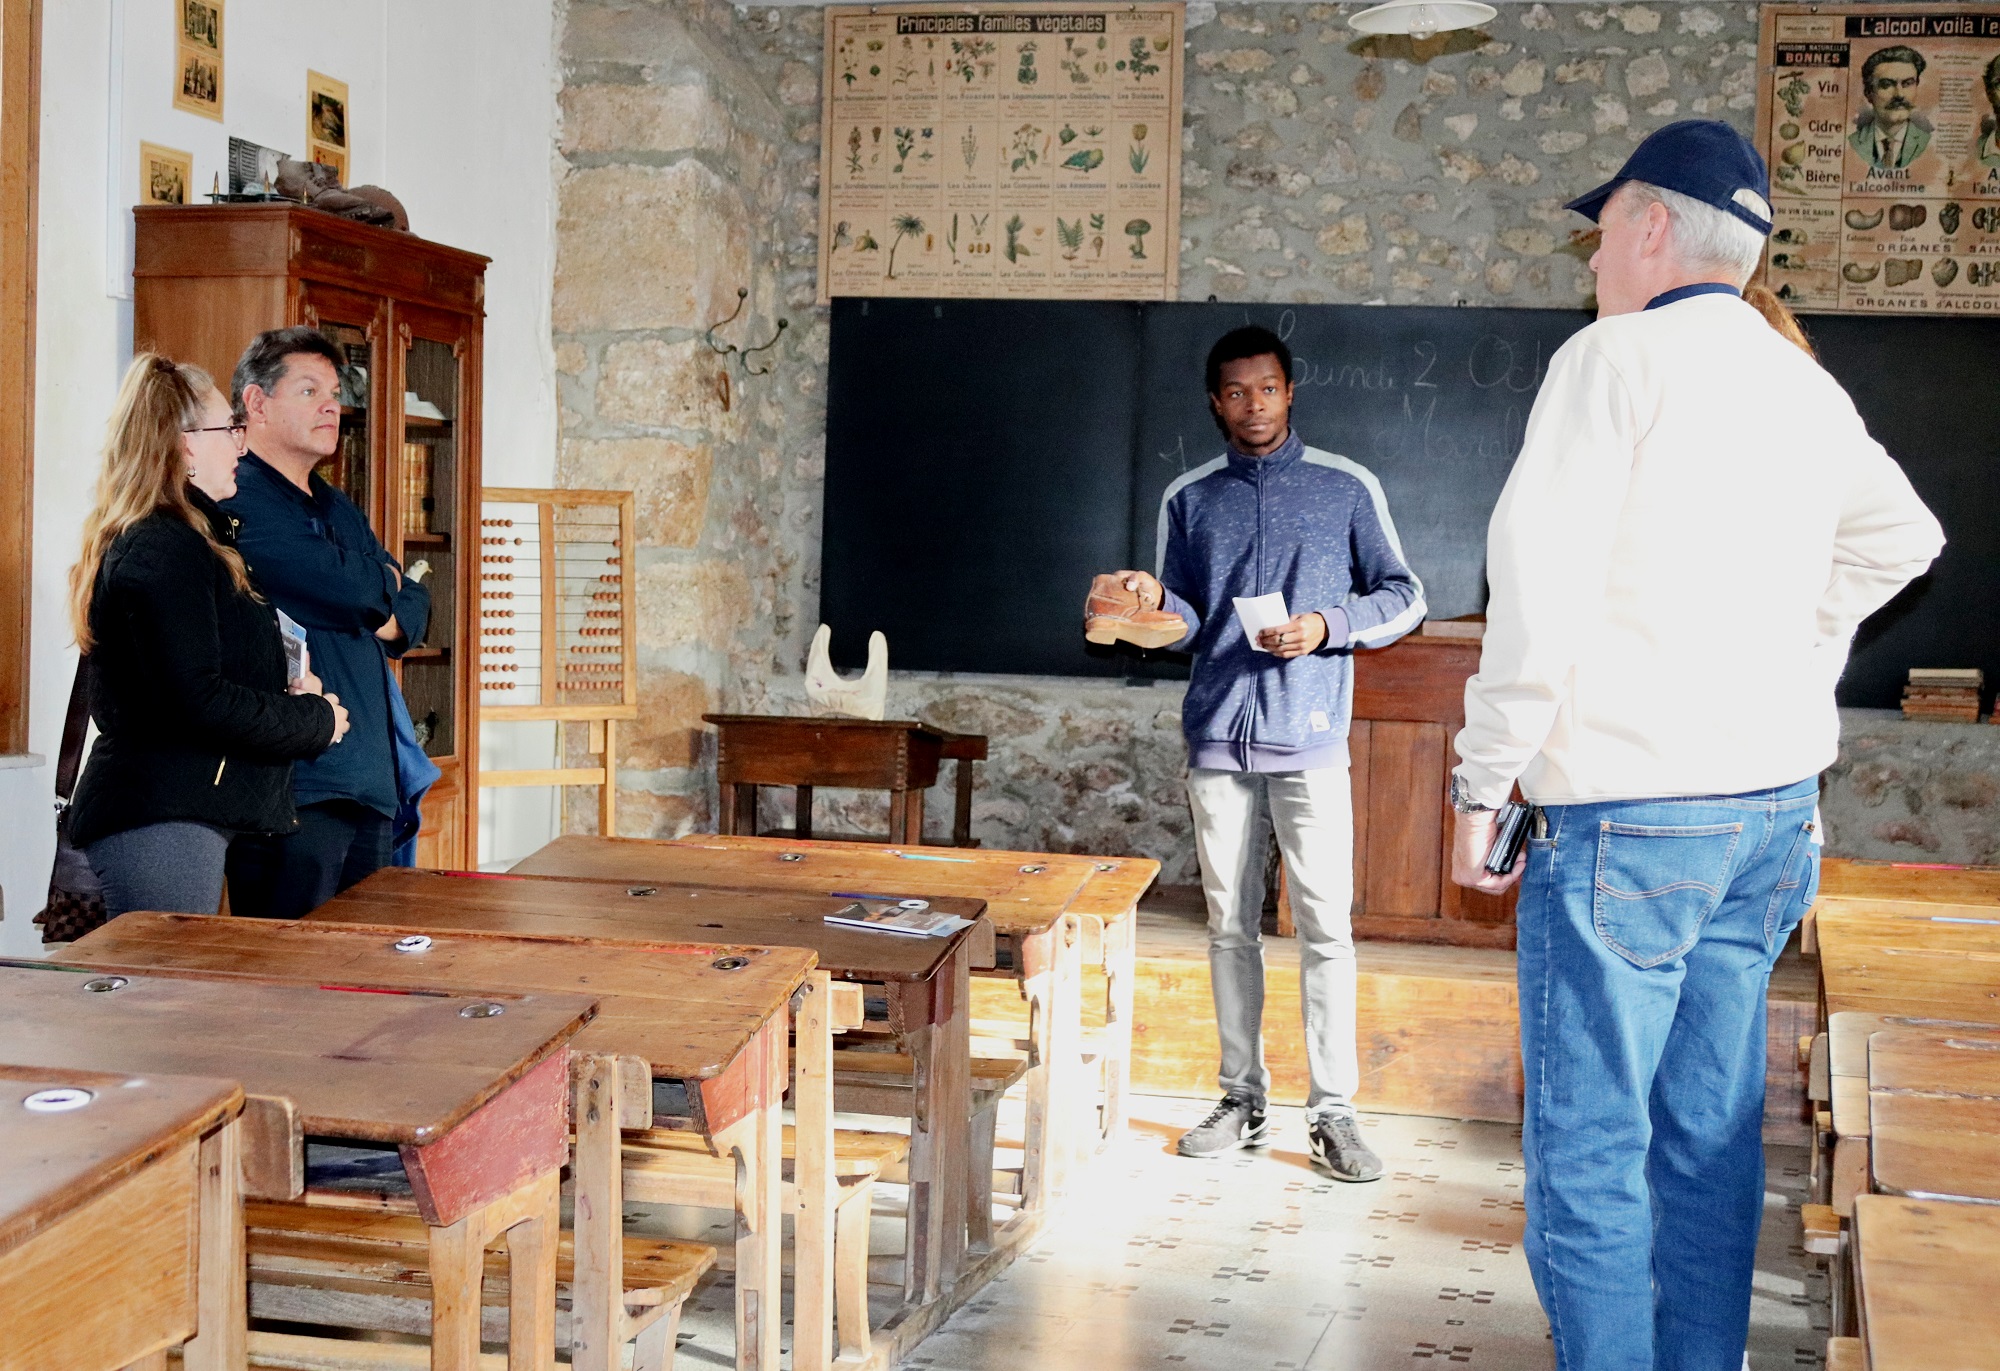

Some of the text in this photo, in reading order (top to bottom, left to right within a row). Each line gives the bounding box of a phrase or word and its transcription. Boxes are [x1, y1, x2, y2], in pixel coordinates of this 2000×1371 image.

[899, 15, 974, 33] Principales
[978, 15, 1031, 32] familles
[1036, 14, 1104, 32] végétales
[1933, 16, 1975, 35] voilà
[1980, 17, 2000, 35] l'e
[1785, 52, 1840, 63] BONNES
[1818, 81, 1839, 93] Vin
[1808, 120, 1842, 133] Cidre
[1807, 144, 1842, 158] Poiré
[1805, 170, 1841, 183] Bière
[1866, 167, 1911, 180] Avant
[1848, 180, 1925, 193] l'alcoolisme
[1876, 242, 1952, 254] ORGANES
[1856, 297, 1928, 309] ORGANES
[1414, 340, 1438, 388] 2
[1468, 333, 1541, 393] Oct
